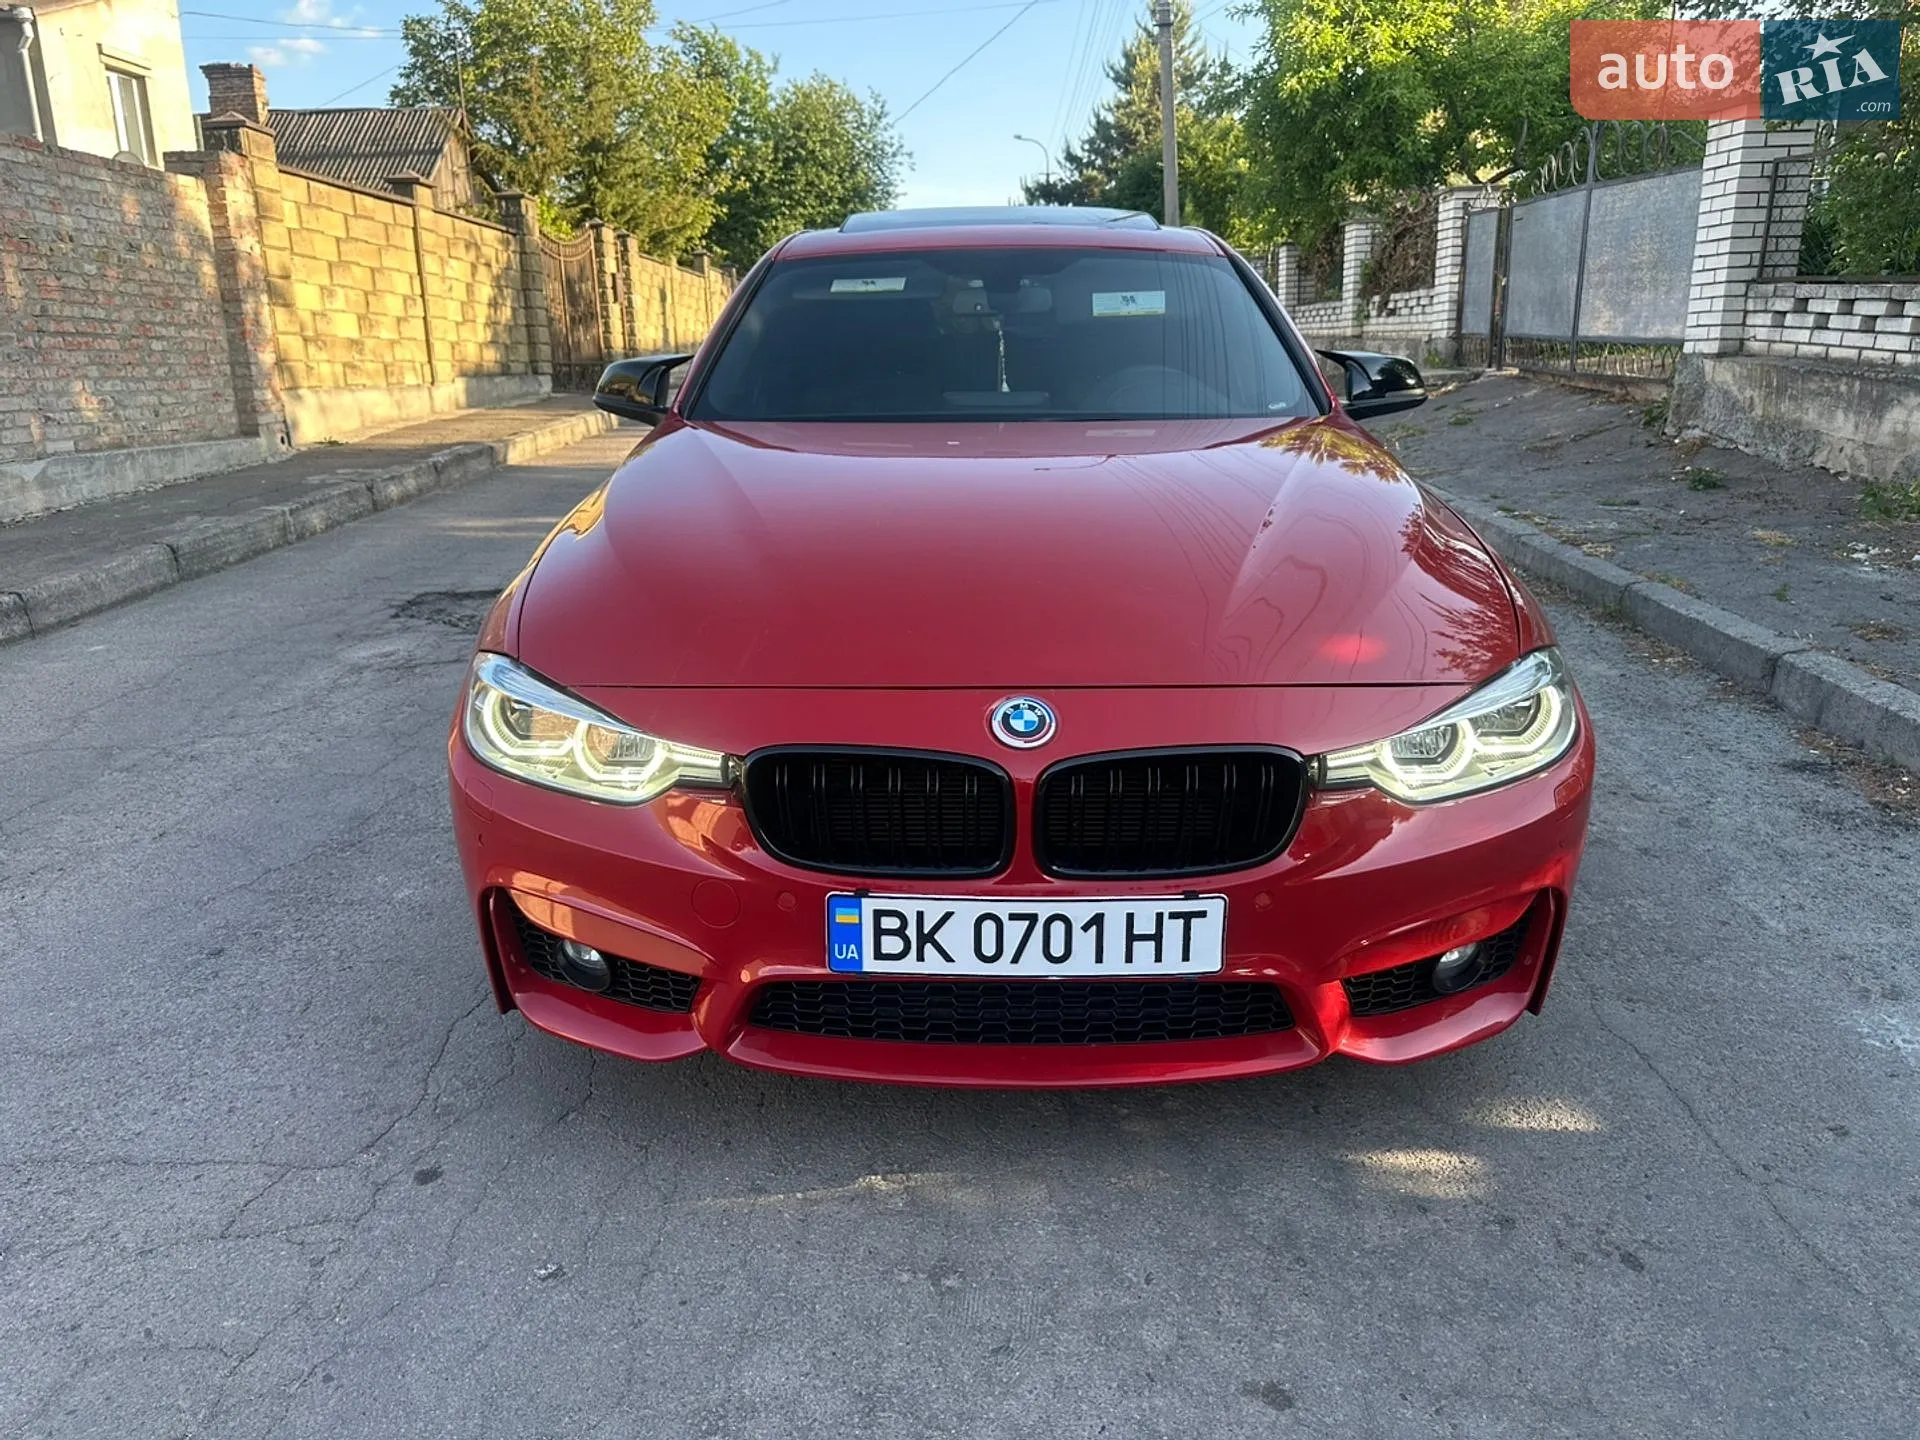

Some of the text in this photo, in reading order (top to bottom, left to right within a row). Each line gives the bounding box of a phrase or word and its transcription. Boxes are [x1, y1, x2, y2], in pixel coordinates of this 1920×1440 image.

[1005, 702, 1043, 716] BMW
[872, 909, 1208, 965] BK 0701 HT
[834, 943, 859, 960] UA
